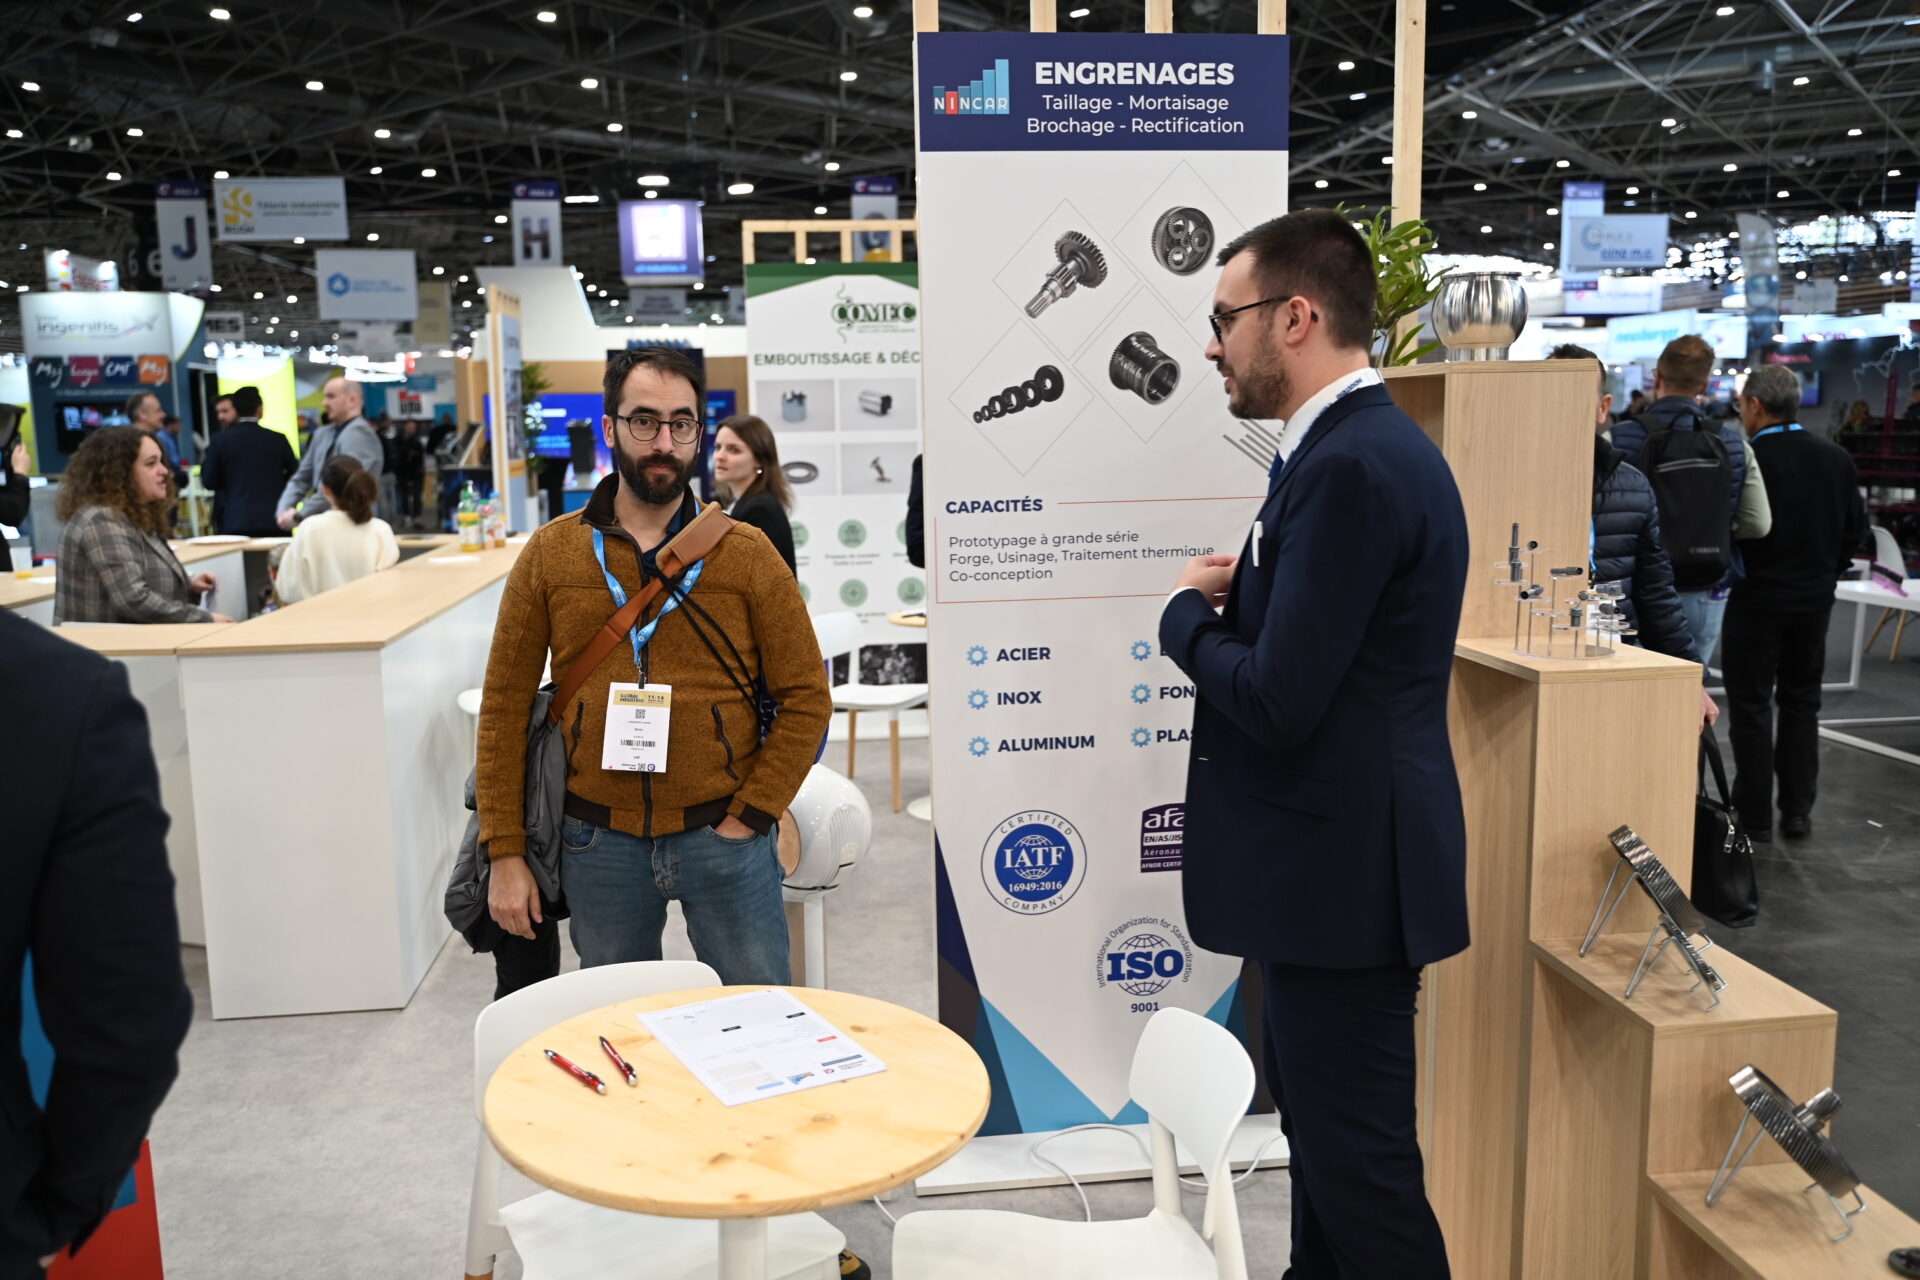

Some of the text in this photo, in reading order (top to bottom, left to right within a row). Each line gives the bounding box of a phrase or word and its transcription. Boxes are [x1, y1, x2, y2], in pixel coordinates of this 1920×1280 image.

[1035, 61, 1235, 86] ENGRENAGES
[933, 97, 1009, 111] NINCAR
[1042, 94, 1112, 112] Taillage
[1129, 94, 1229, 112] Mortaisage
[1026, 117, 1115, 136] Brochage
[1131, 117, 1245, 134] Rectification
[171, 215, 198, 260] J
[521, 216, 552, 261] H
[754, 351, 873, 366] EMBOUTISSAGE
[876, 352, 886, 364] &
[945, 496, 1043, 514] CAPACITÉS
[949, 530, 1139, 549] Prototypage à grande série
[949, 545, 1215, 567] Forge, Usinage, Traitement thermique
[949, 568, 1053, 582] Co-conception
[996, 647, 1051, 662] ACIER
[997, 690, 1042, 706] INOX
[1159, 686, 1195, 700] FON
[998, 735, 1095, 753] ALUMINUM
[1156, 729, 1193, 743] PLA
[1000, 813, 1073, 836] CERTIFIED
[1003, 845, 1066, 869] IATF
[1008, 880, 1063, 893] 16949:2016
[1003, 894, 1065, 911] COMPANY
[1096, 916, 1193, 988] International Organization for Standardization
[1106, 948, 1185, 982] ISO
[1130, 1002, 1160, 1013] 9001
